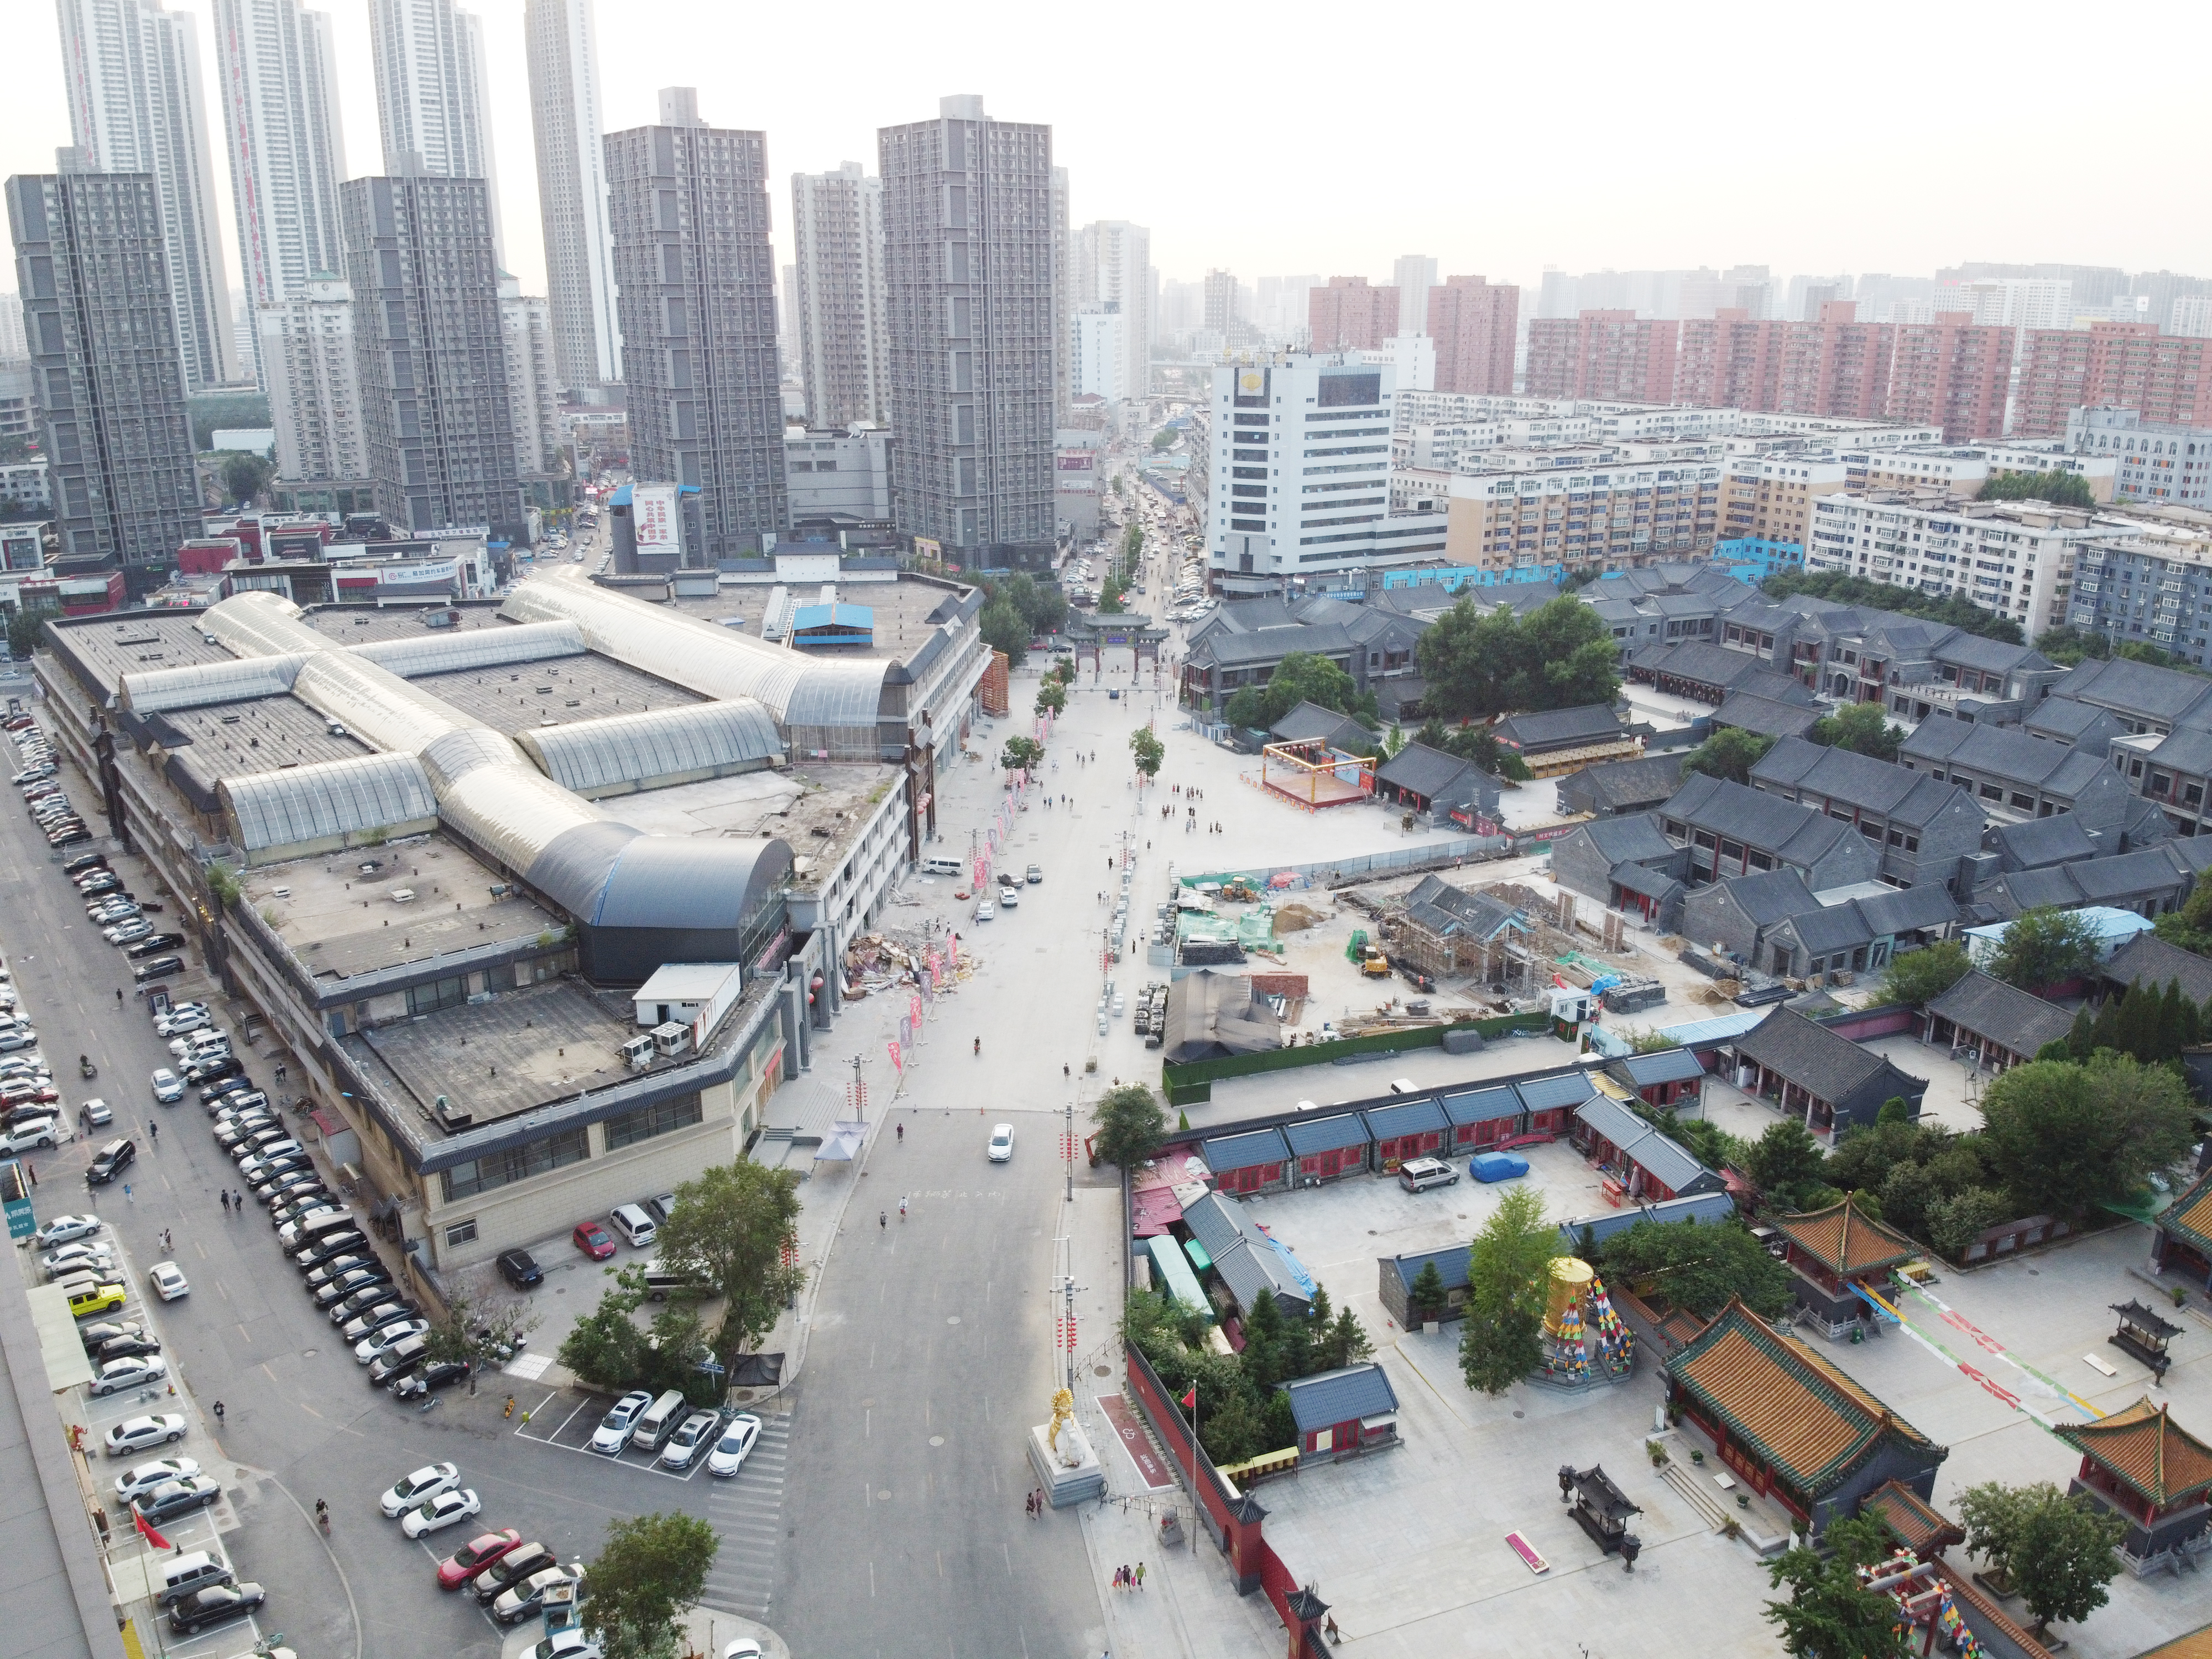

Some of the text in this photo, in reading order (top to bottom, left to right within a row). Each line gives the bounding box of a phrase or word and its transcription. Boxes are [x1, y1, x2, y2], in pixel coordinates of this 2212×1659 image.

[413, 564, 456, 576] 易加网约车服务中心
[1140, 1454, 1157, 1474] 沈阳单车
